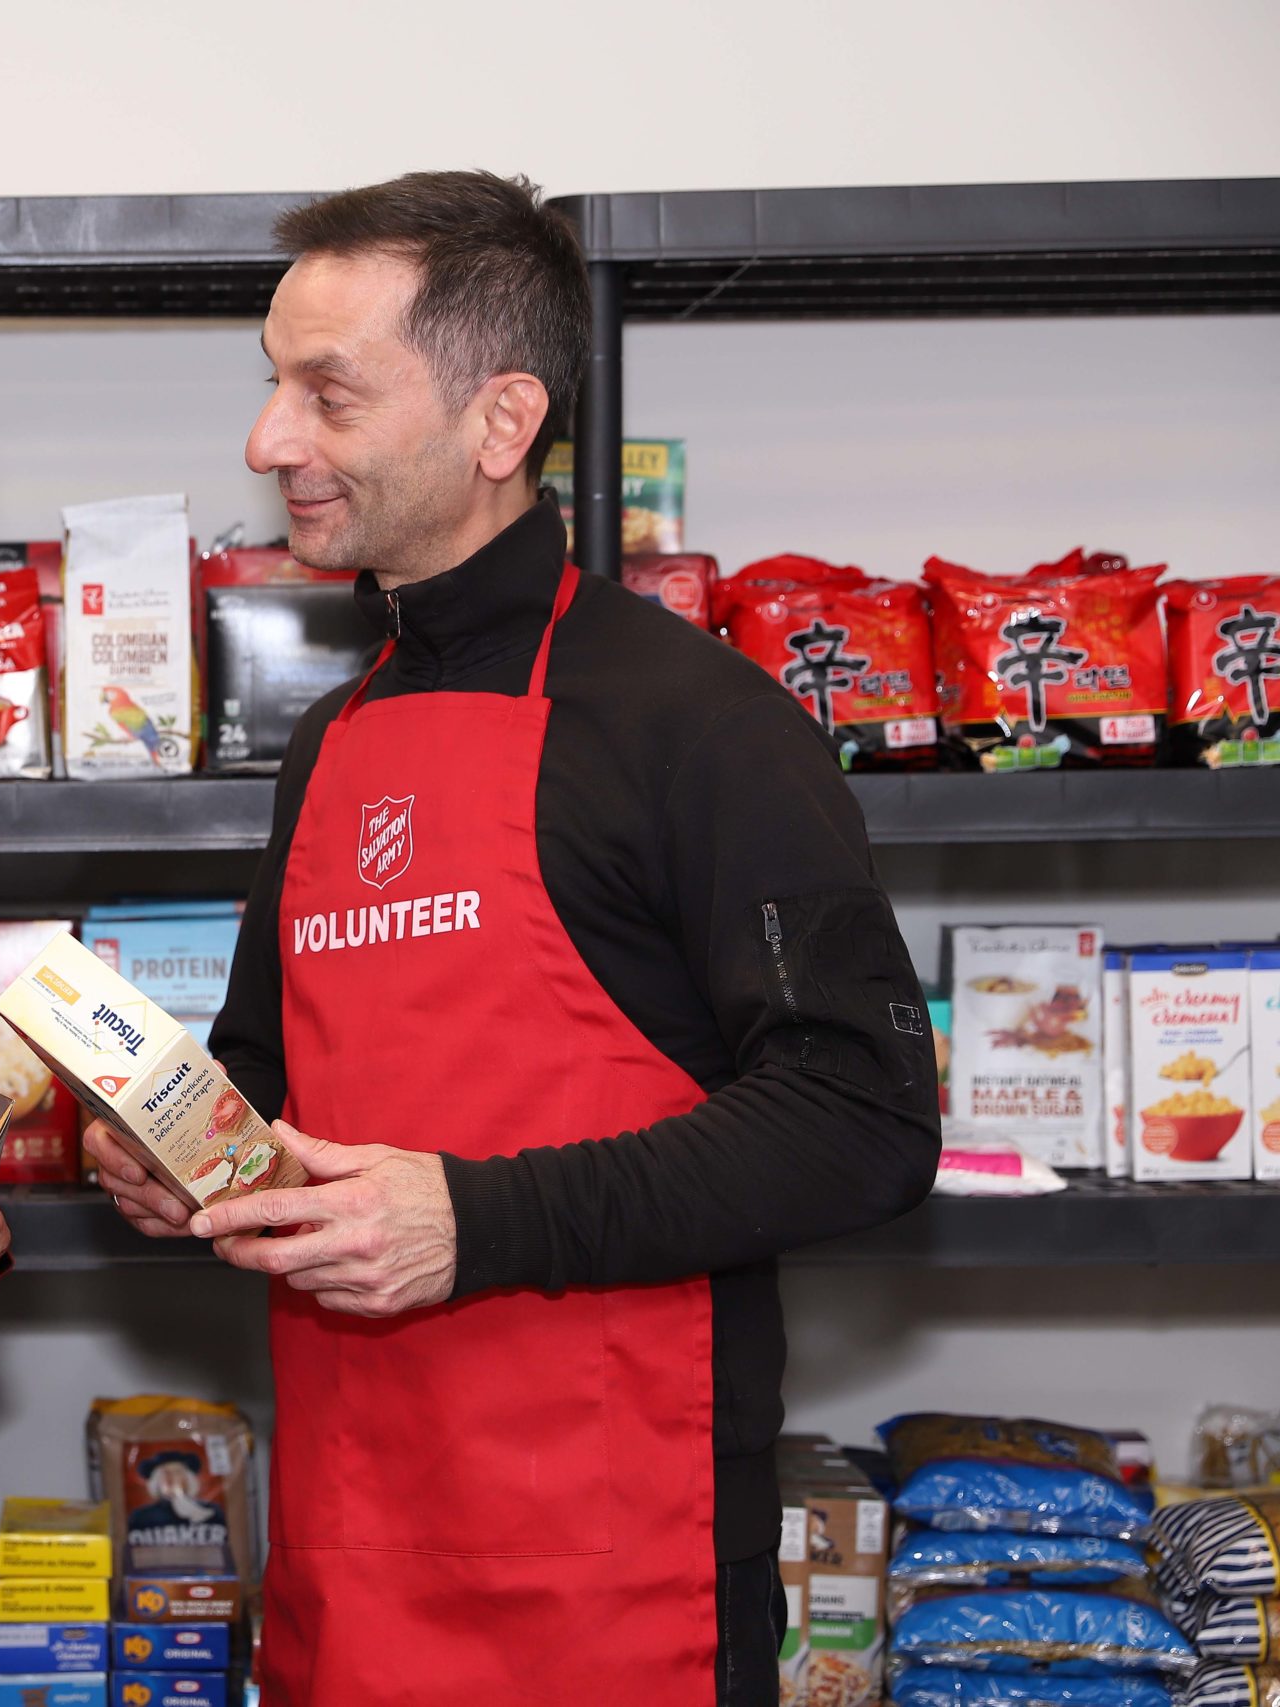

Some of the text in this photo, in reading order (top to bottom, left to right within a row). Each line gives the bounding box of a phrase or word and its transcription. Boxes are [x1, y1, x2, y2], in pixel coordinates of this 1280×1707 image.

[782, 617, 871, 736] 辛
[996, 611, 1089, 732] 辛
[219, 723, 248, 744] 24
[1105, 721, 1118, 740] 4
[361, 809, 407, 868] SALVATION
[368, 805, 390, 838] THE
[375, 834, 406, 878] ARMY
[293, 890, 481, 956] VOLUNTEER
[131, 957, 228, 982] PROTEIN
[92, 1003, 146, 1057] Triscuit
[141, 1060, 193, 1115] Triscuit
[148, 1068, 209, 1135] 3 Steps to Delicious
[154, 1077, 217, 1142] Délice en 3 étapes
[128, 1525, 227, 1546] QUAKER
[163, 1648, 214, 1660] ORIGINAL
